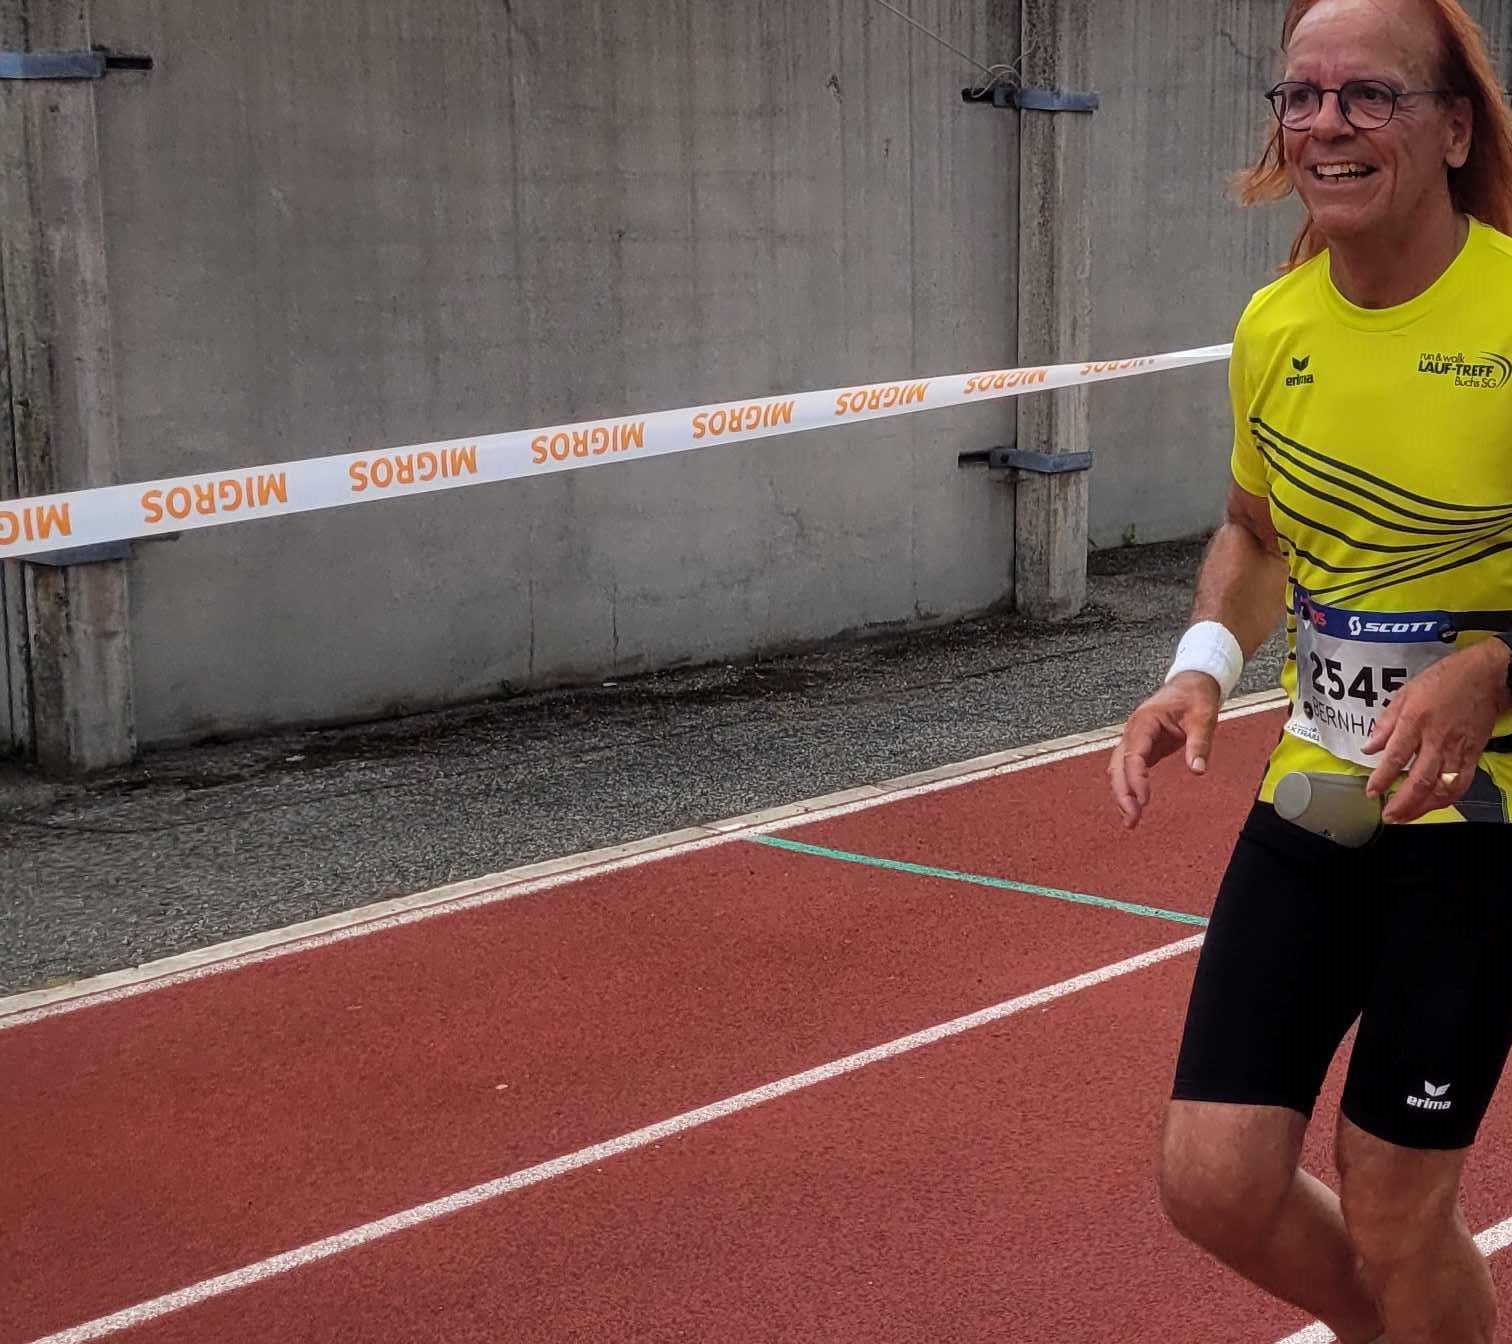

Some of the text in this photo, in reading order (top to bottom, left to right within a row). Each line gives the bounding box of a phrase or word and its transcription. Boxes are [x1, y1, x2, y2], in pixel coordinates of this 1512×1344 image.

[963, 369, 1047, 394] MIGROS
[1286, 374, 1314, 386] erima
[1418, 361, 1495, 377] LAUF-TREFF
[1481, 377, 1497, 388] SG
[834, 382, 930, 416] MIGROS
[692, 401, 795, 439] MIGROS
[530, 422, 646, 465] MIGROS
[349, 444, 478, 492] MIGROS
[140, 472, 288, 524] MIGROS
[1363, 621, 1438, 633] SCOTT
[1310, 651, 1408, 708] 2545
[1407, 1095, 1452, 1109] erima
